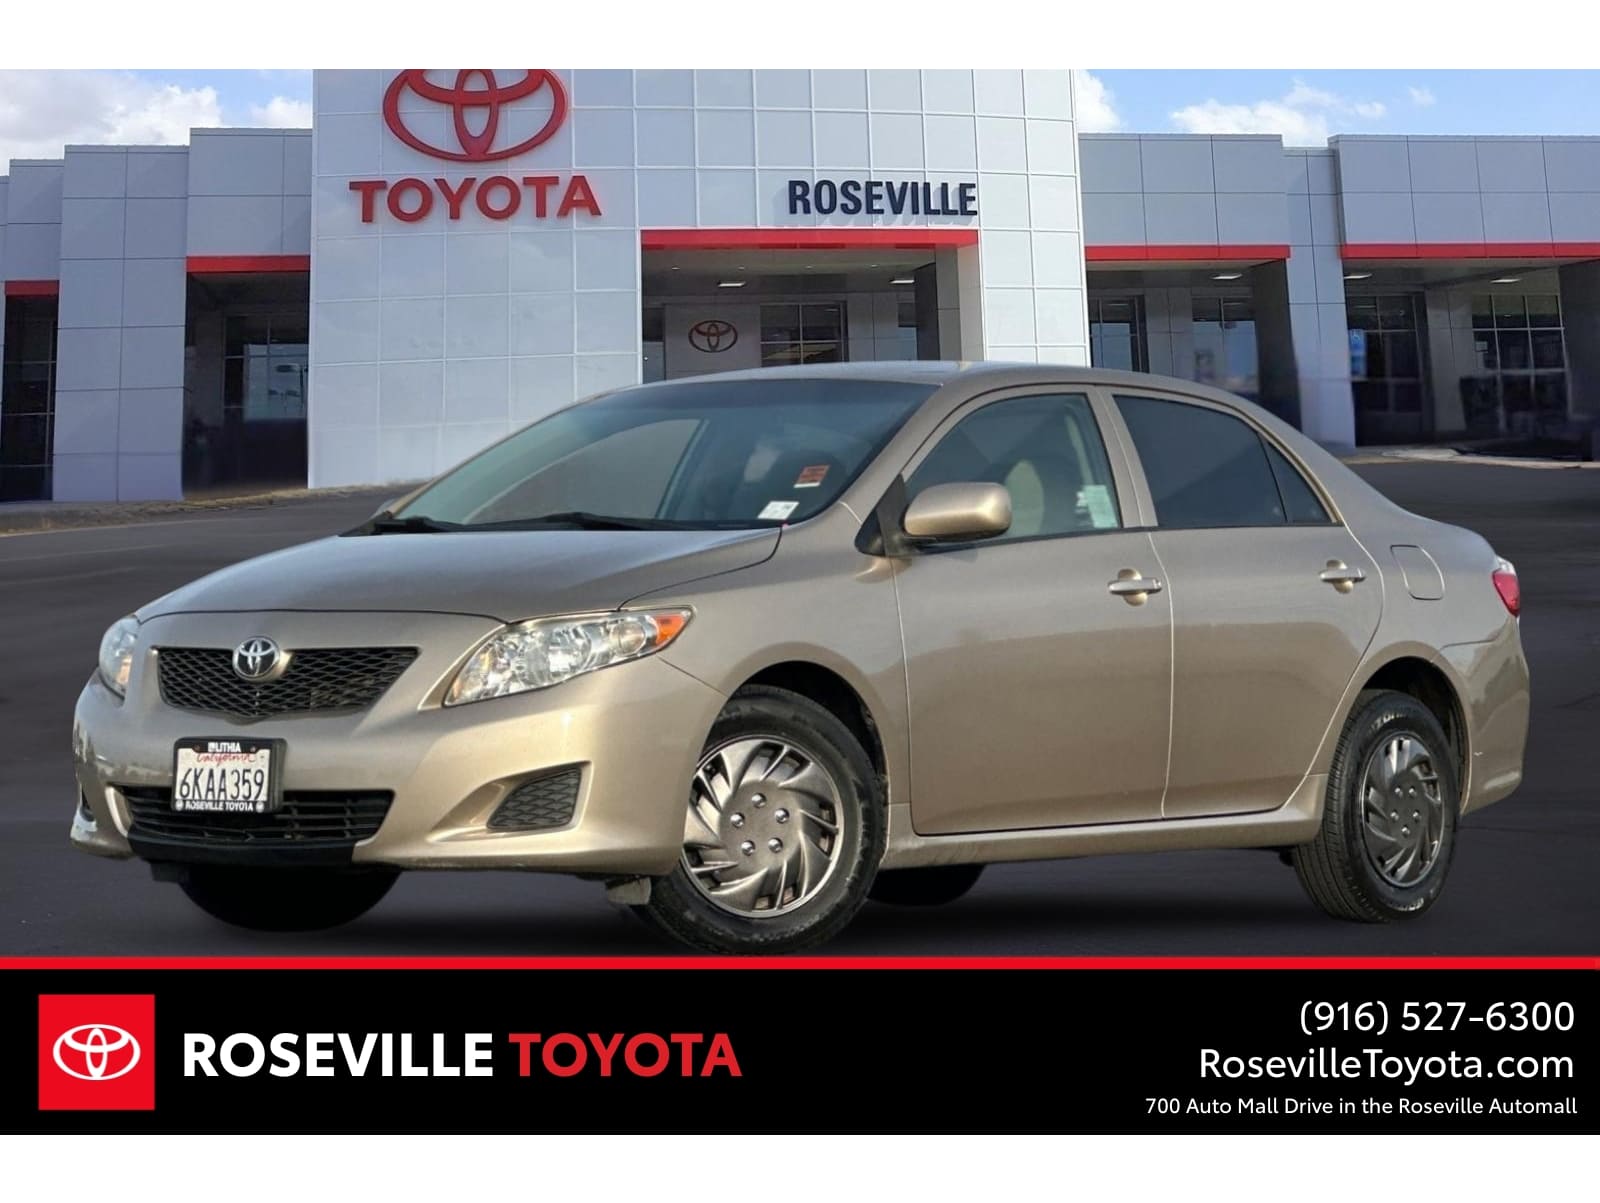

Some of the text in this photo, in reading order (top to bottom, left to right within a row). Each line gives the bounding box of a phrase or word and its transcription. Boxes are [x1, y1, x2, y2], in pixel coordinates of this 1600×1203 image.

[348, 175, 602, 223] TOYOTA
[788, 179, 979, 217] ROSEVILLE
[216, 741, 241, 753] LITHIA
[180, 767, 265, 801] 6KAA359
[185, 801, 254, 812] ROSEVILLE TOYOTA
